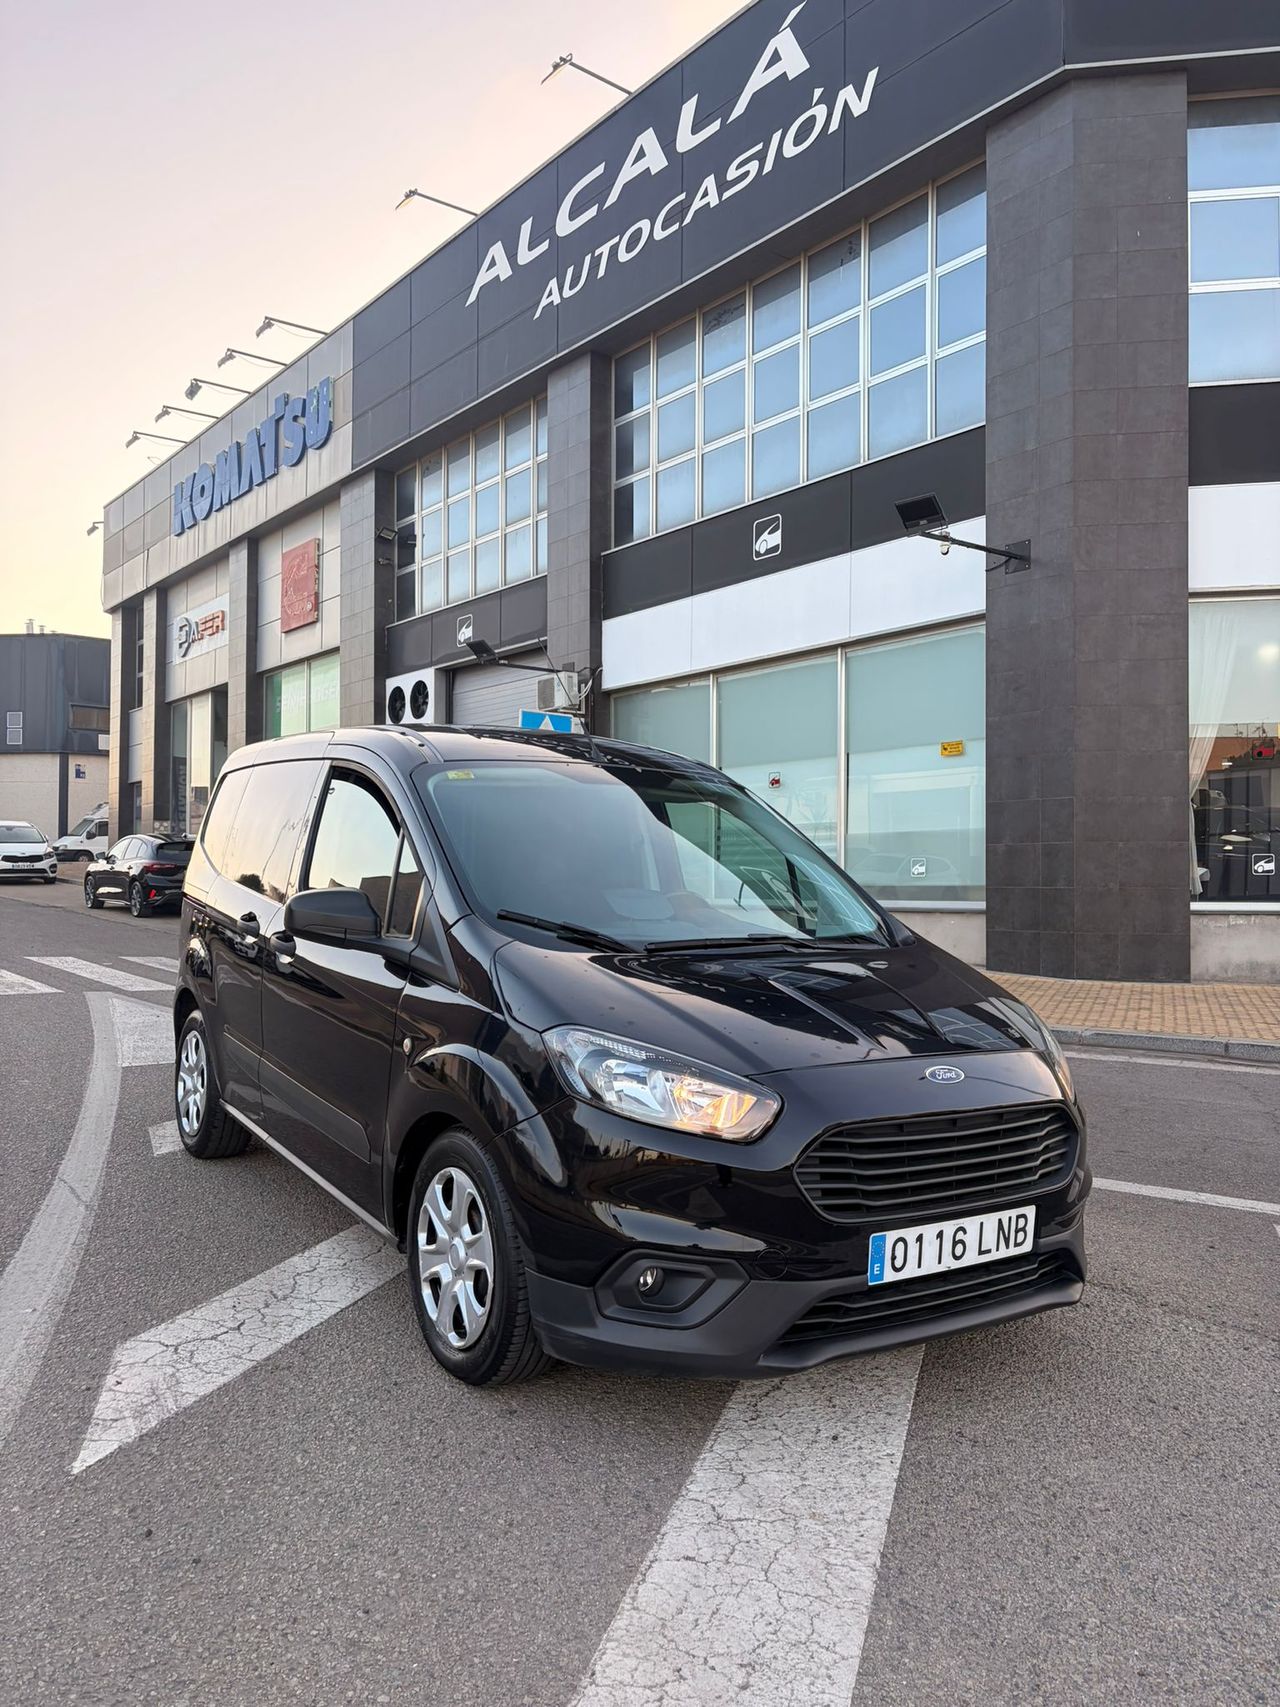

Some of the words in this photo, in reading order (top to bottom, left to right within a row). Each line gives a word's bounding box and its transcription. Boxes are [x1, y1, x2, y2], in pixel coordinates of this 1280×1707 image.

[465, 0, 811, 307] ALCALÁ
[533, 66, 880, 320] AUTOCASIÓN
[172, 376, 335, 537] KOMATSU
[873, 1263, 881, 1275] E
[890, 1226, 968, 1273] 0116
[977, 1213, 1029, 1256] LNB
